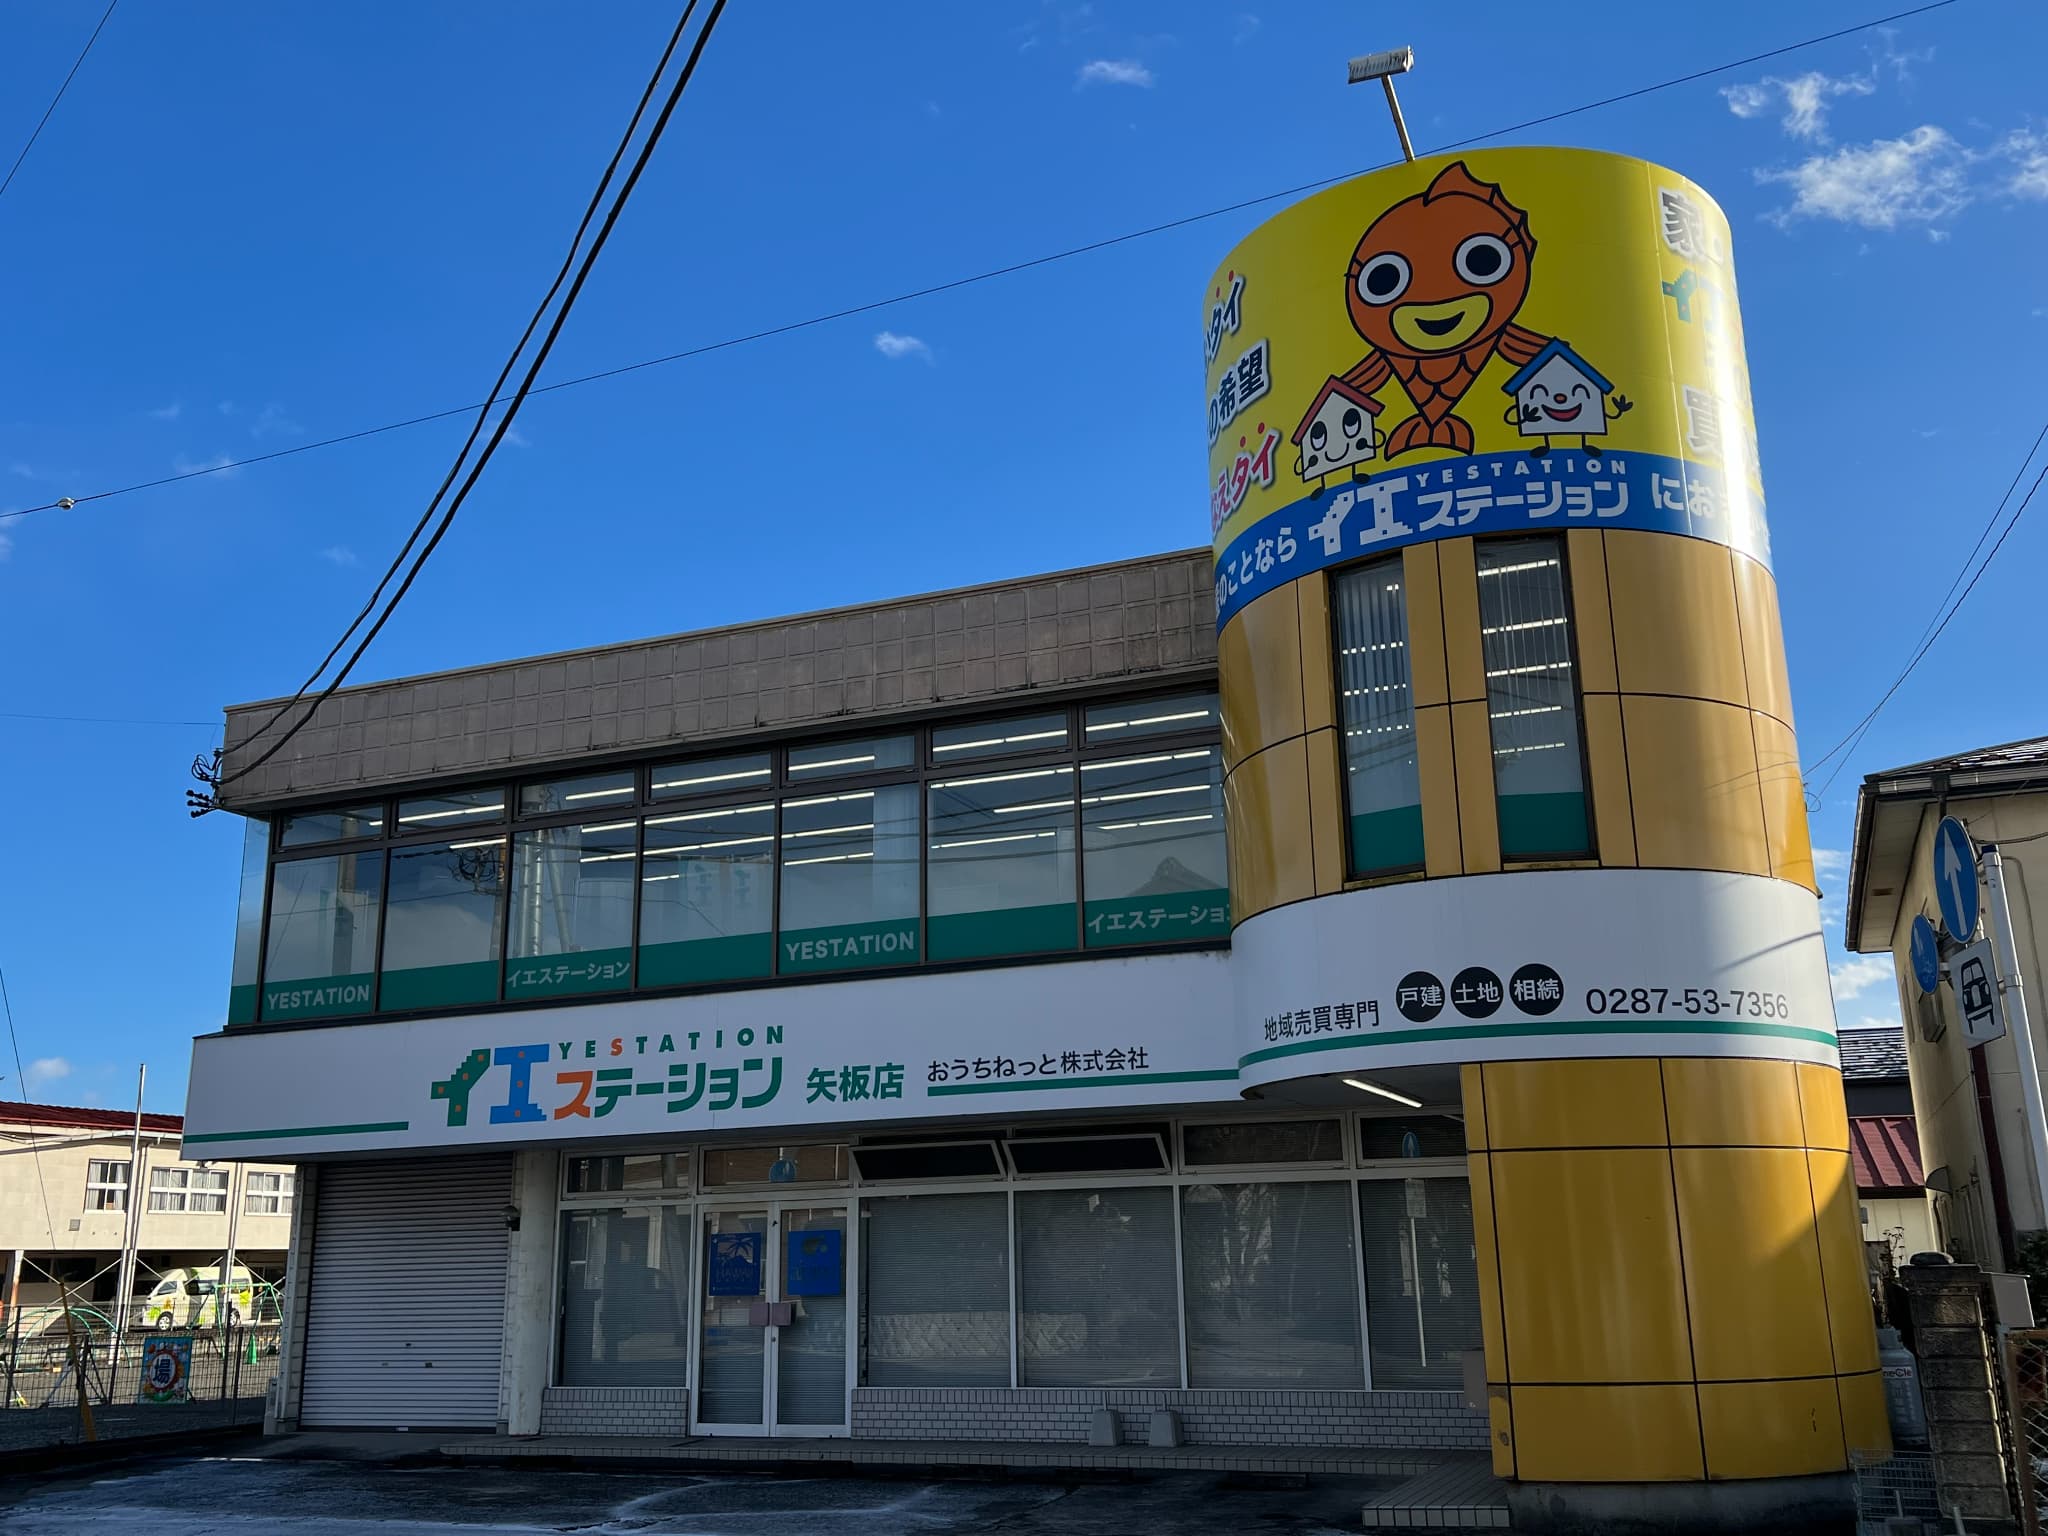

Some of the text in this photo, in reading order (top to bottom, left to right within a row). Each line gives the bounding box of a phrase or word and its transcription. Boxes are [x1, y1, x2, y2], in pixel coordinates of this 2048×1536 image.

[1416, 459, 1627, 488] YESTATION
[1308, 475, 1630, 557] イエステーション
[785, 931, 915, 962] YESTATION
[507, 960, 631, 988] イエステーション
[1513, 977, 1561, 1002] 相続
[267, 983, 370, 1011] YESTATION
[1399, 983, 1443, 1010] 戸建
[1454, 980, 1499, 1006] 土地
[1586, 987, 1789, 1020] 0287-53-7356
[1264, 999, 1380, 1043] 地域売買専門
[558, 1024, 784, 1060] YESTATION
[927, 1045, 1150, 1083] おうちねっと株式会社
[430, 1043, 783, 1127] イエステーション
[806, 1062, 905, 1104] 矢板店
